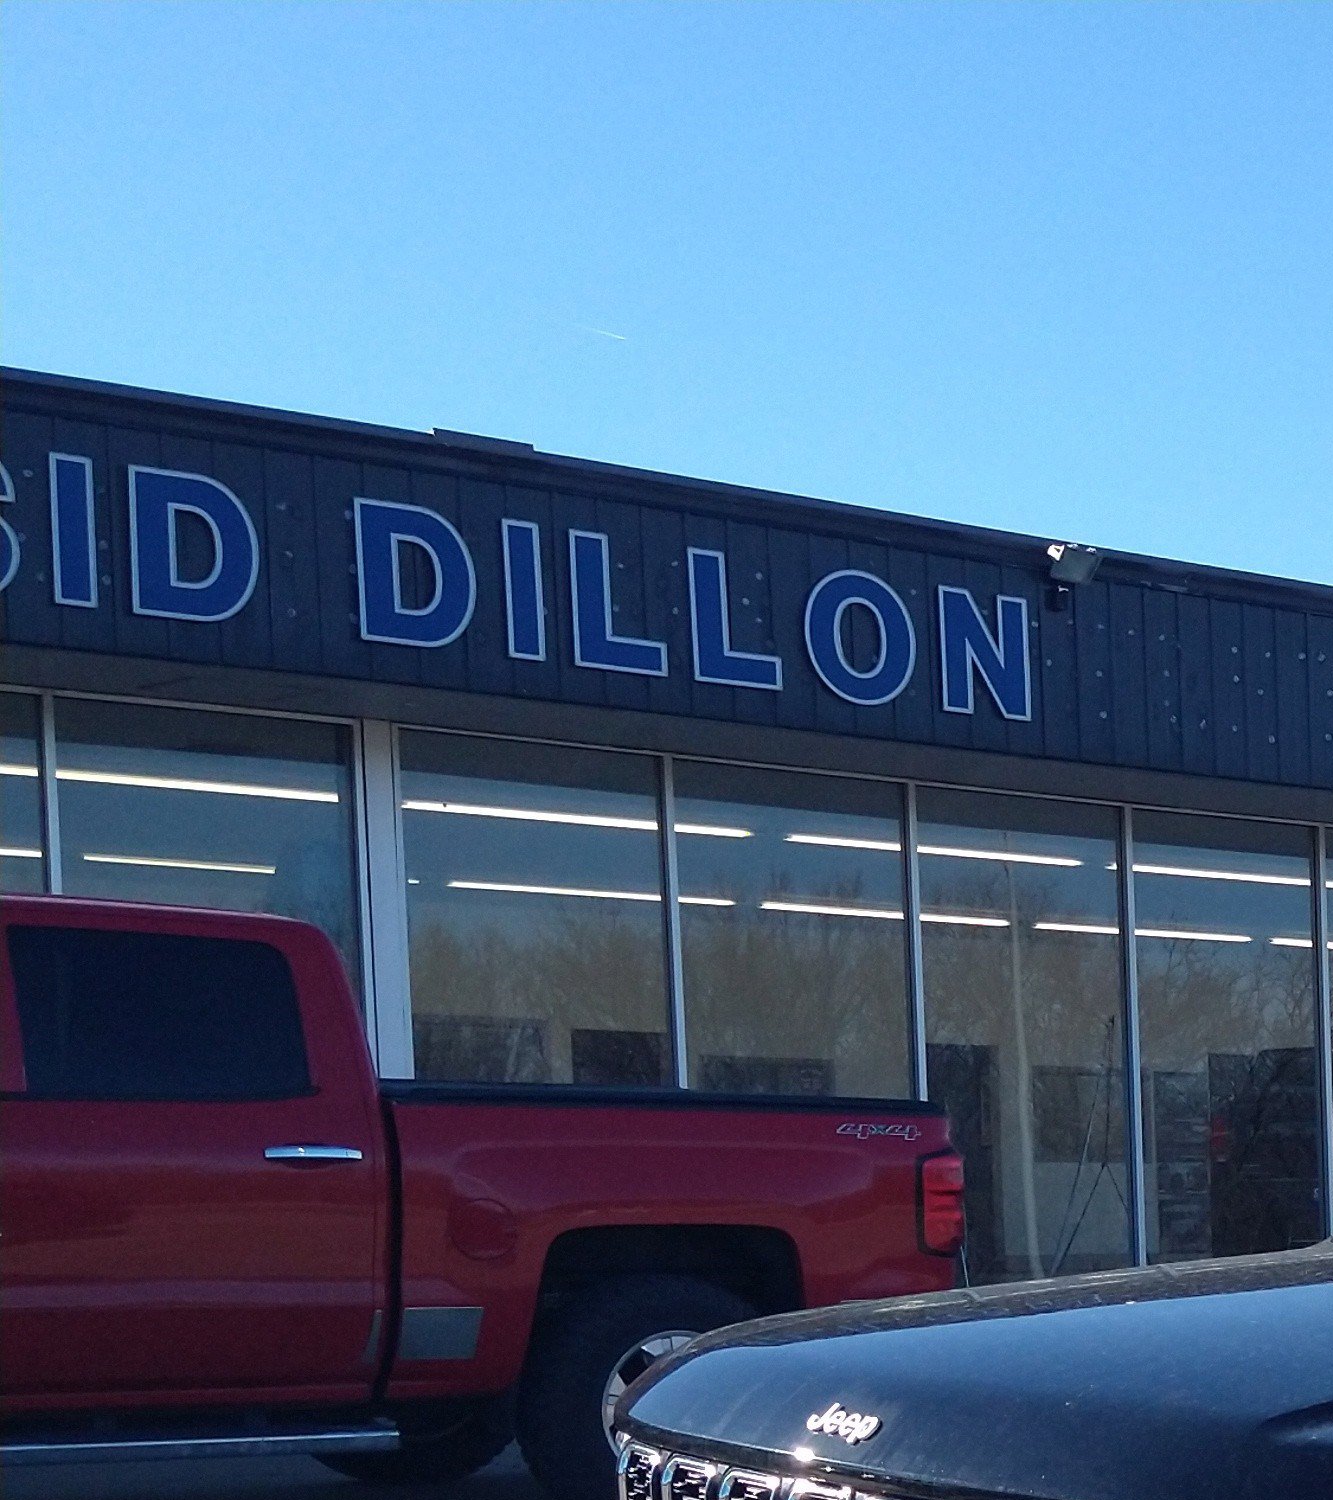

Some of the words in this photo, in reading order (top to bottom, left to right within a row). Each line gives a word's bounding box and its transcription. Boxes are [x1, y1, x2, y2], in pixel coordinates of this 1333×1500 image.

[0, 451, 259, 622] ID
[352, 496, 1031, 721] DILLON
[806, 1402, 880, 1444] Jeep
